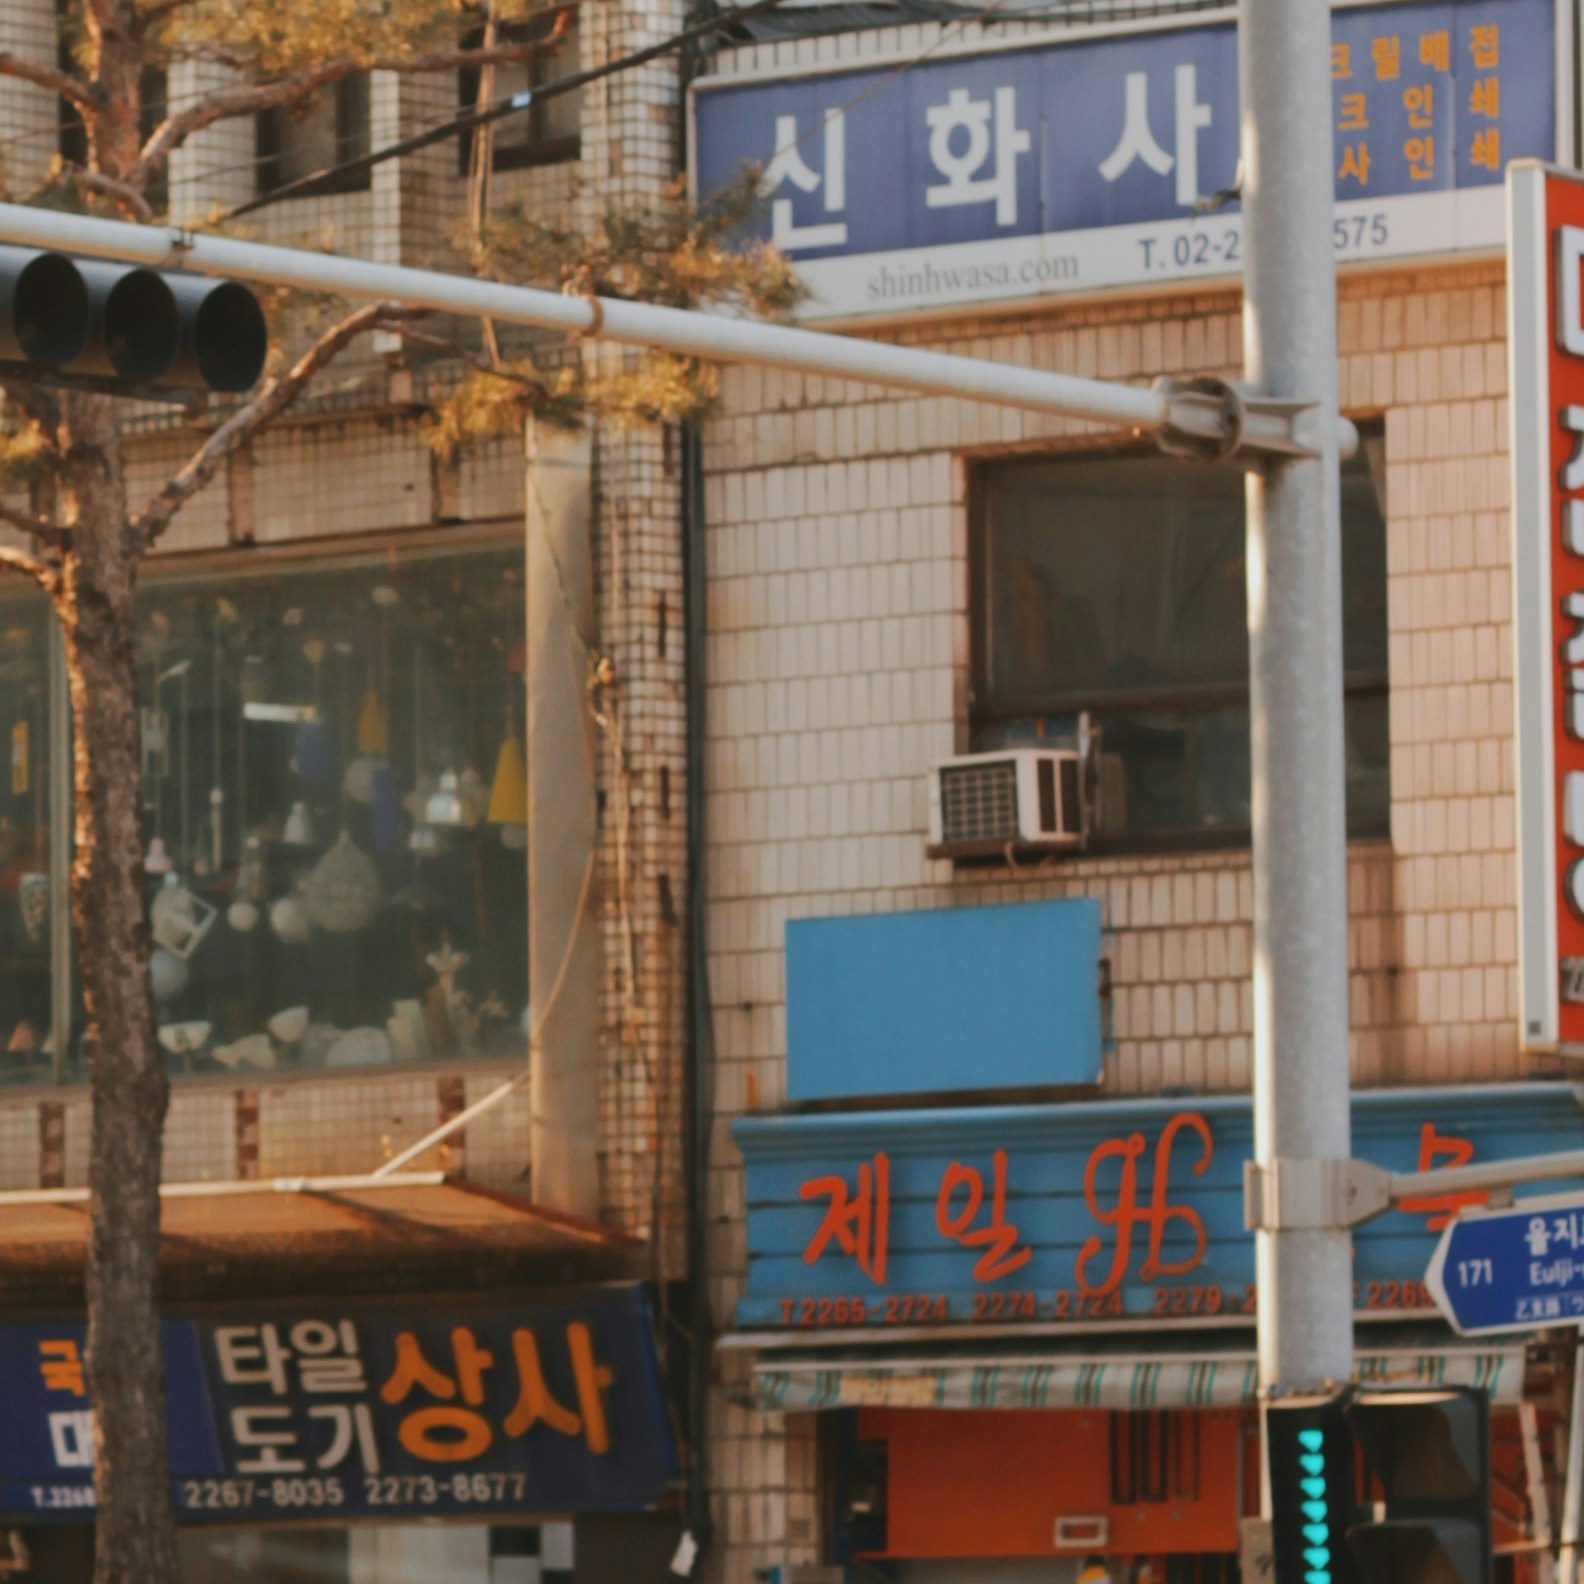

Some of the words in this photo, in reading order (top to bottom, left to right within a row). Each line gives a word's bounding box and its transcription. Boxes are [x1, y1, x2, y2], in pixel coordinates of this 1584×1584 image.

[1338, 77, 1500, 131] 크인쇄
[1338, 128, 1500, 185] 사인쇄
[868, 253, 1080, 300] shinhwasa.com
[1525, 1212, 1584, 1256] 을지
[1458, 1259, 1493, 1287] 171
[1530, 1261, 1584, 1288] Eulji-
[1153, 1283, 1256, 1314] 2279-2
[216, 1319, 367, 1395] 타일
[381, 1321, 613, 1463] 상사
[231, 1404, 381, 1473] 도기
[184, 1480, 343, 1508] 2267-8035
[365, 1472, 527, 1504] 2273-8677
